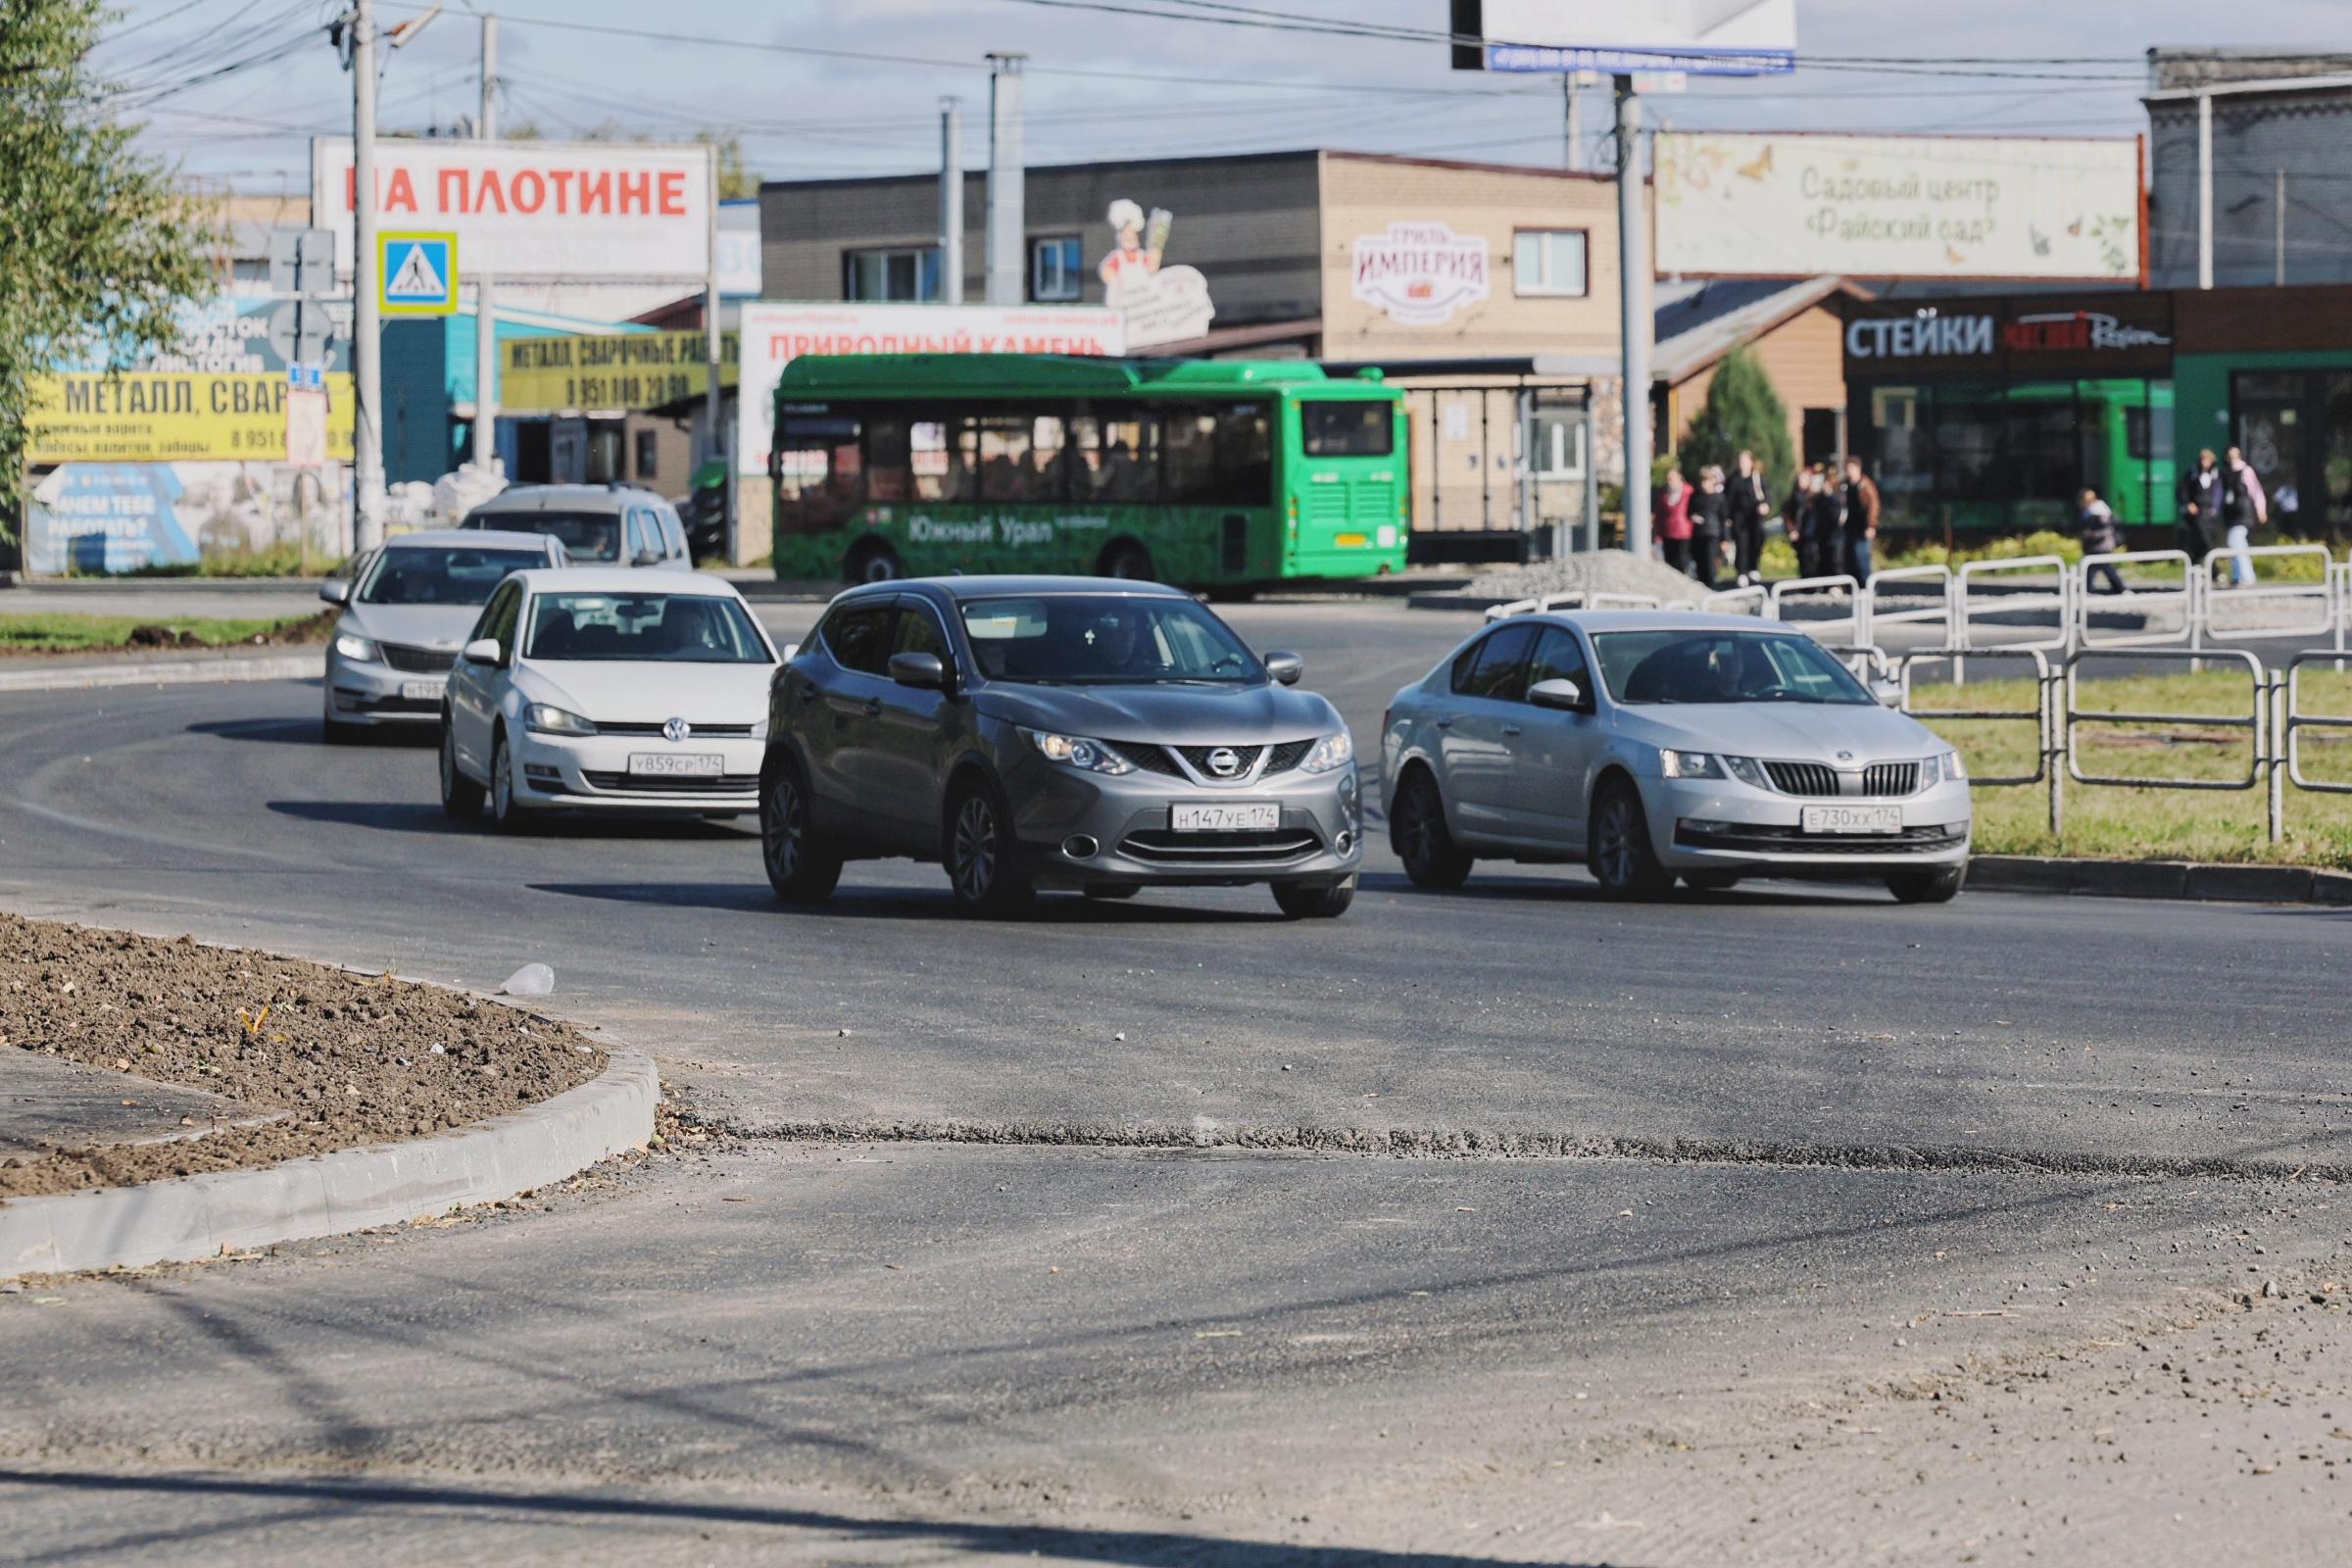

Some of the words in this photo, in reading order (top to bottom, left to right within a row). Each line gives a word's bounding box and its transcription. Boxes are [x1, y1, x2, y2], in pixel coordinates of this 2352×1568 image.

[438, 168, 686, 215] ПЛОТИНЕ
[1800, 165, 1921, 202] Садовый
[1926, 175, 2000, 211] центр
[1357, 250, 1483, 284] ИМПЕРИЯ
[1846, 307, 1994, 358] СТЕЙКИ
[65, 379, 201, 416] МЕТАЛЛ,
[908, 514, 993, 543] Южный
[998, 516, 1054, 548] Урал
[698, 757, 720, 770] 174
[1250, 808, 1275, 822] 174
[1874, 808, 1899, 822] 174
